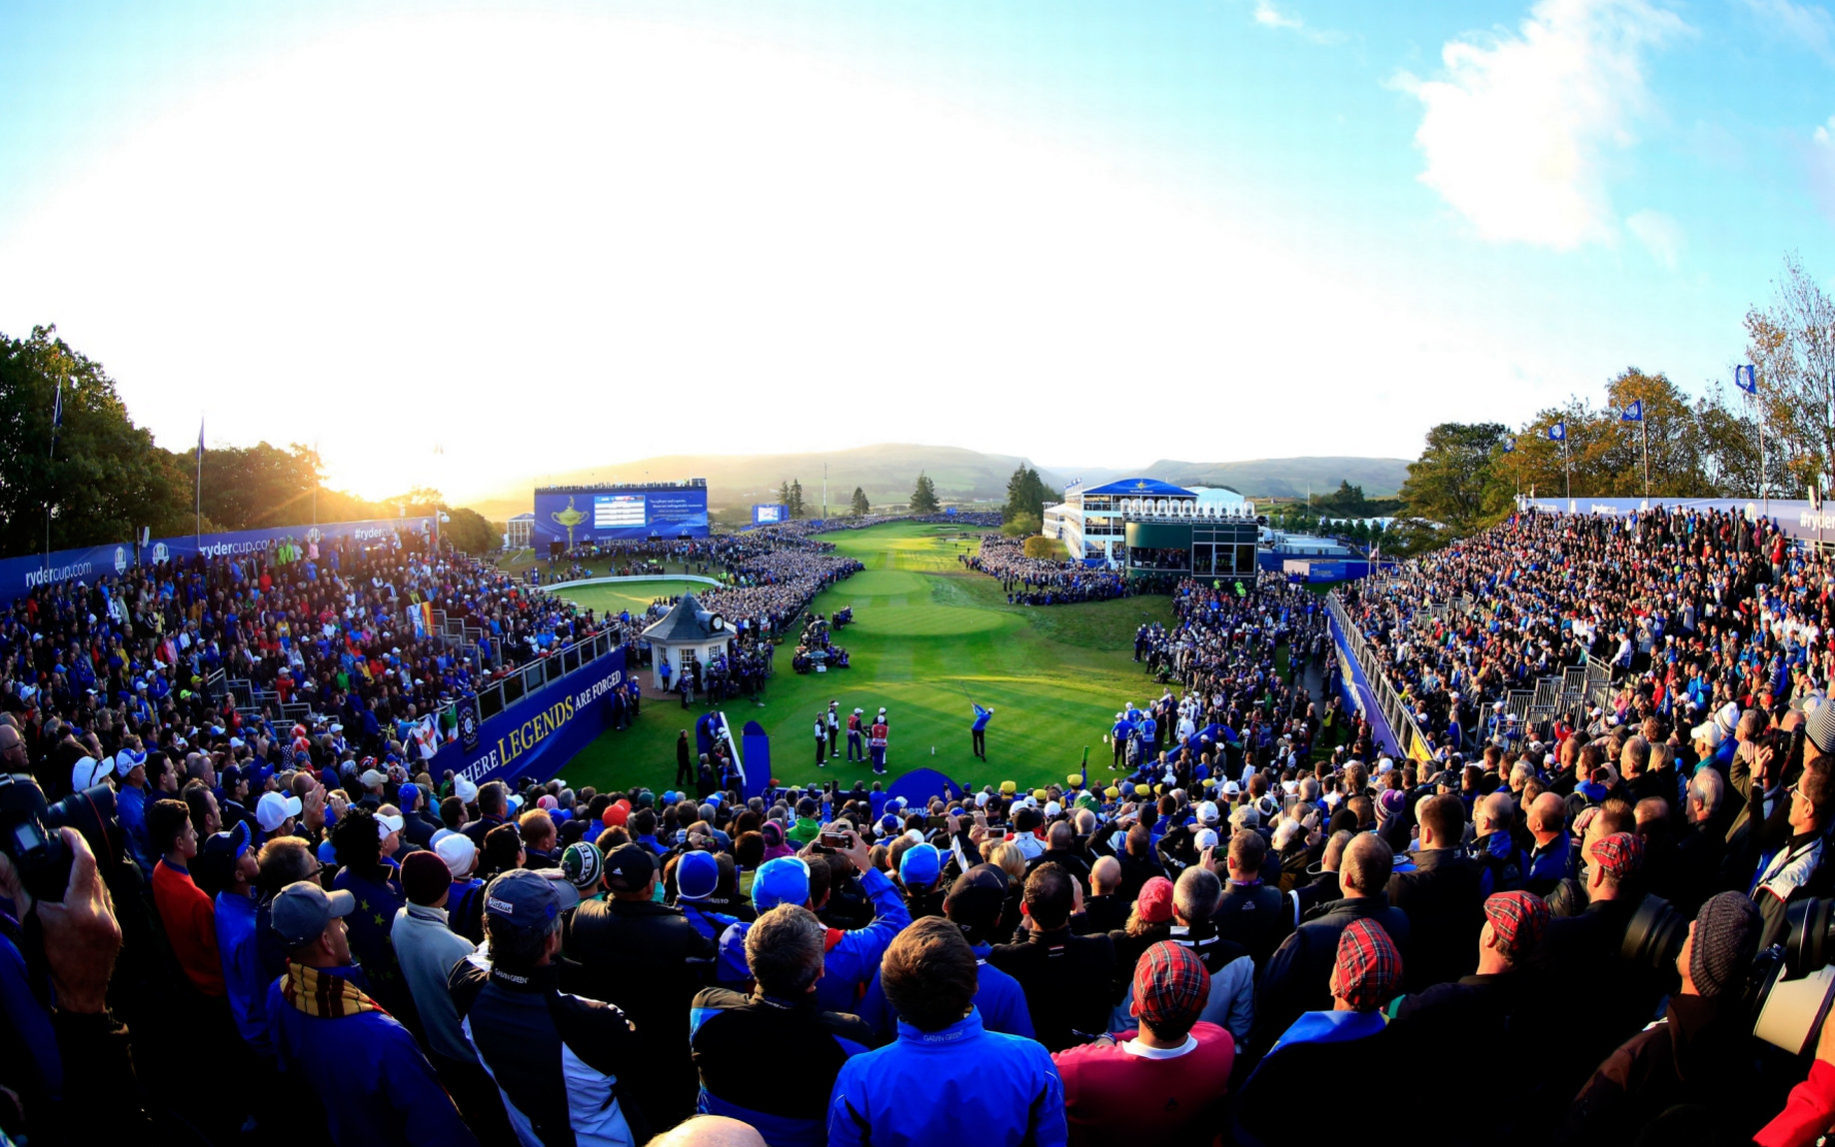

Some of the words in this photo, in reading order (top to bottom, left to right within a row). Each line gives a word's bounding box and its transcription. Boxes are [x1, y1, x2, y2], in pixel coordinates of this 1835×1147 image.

[25, 561, 92, 589] rydercup.com
[461, 749, 499, 783] HERE
[497, 695, 574, 767] LEGENDS
[575, 689, 592, 712] ARE
[592, 670, 622, 700] FORGED
